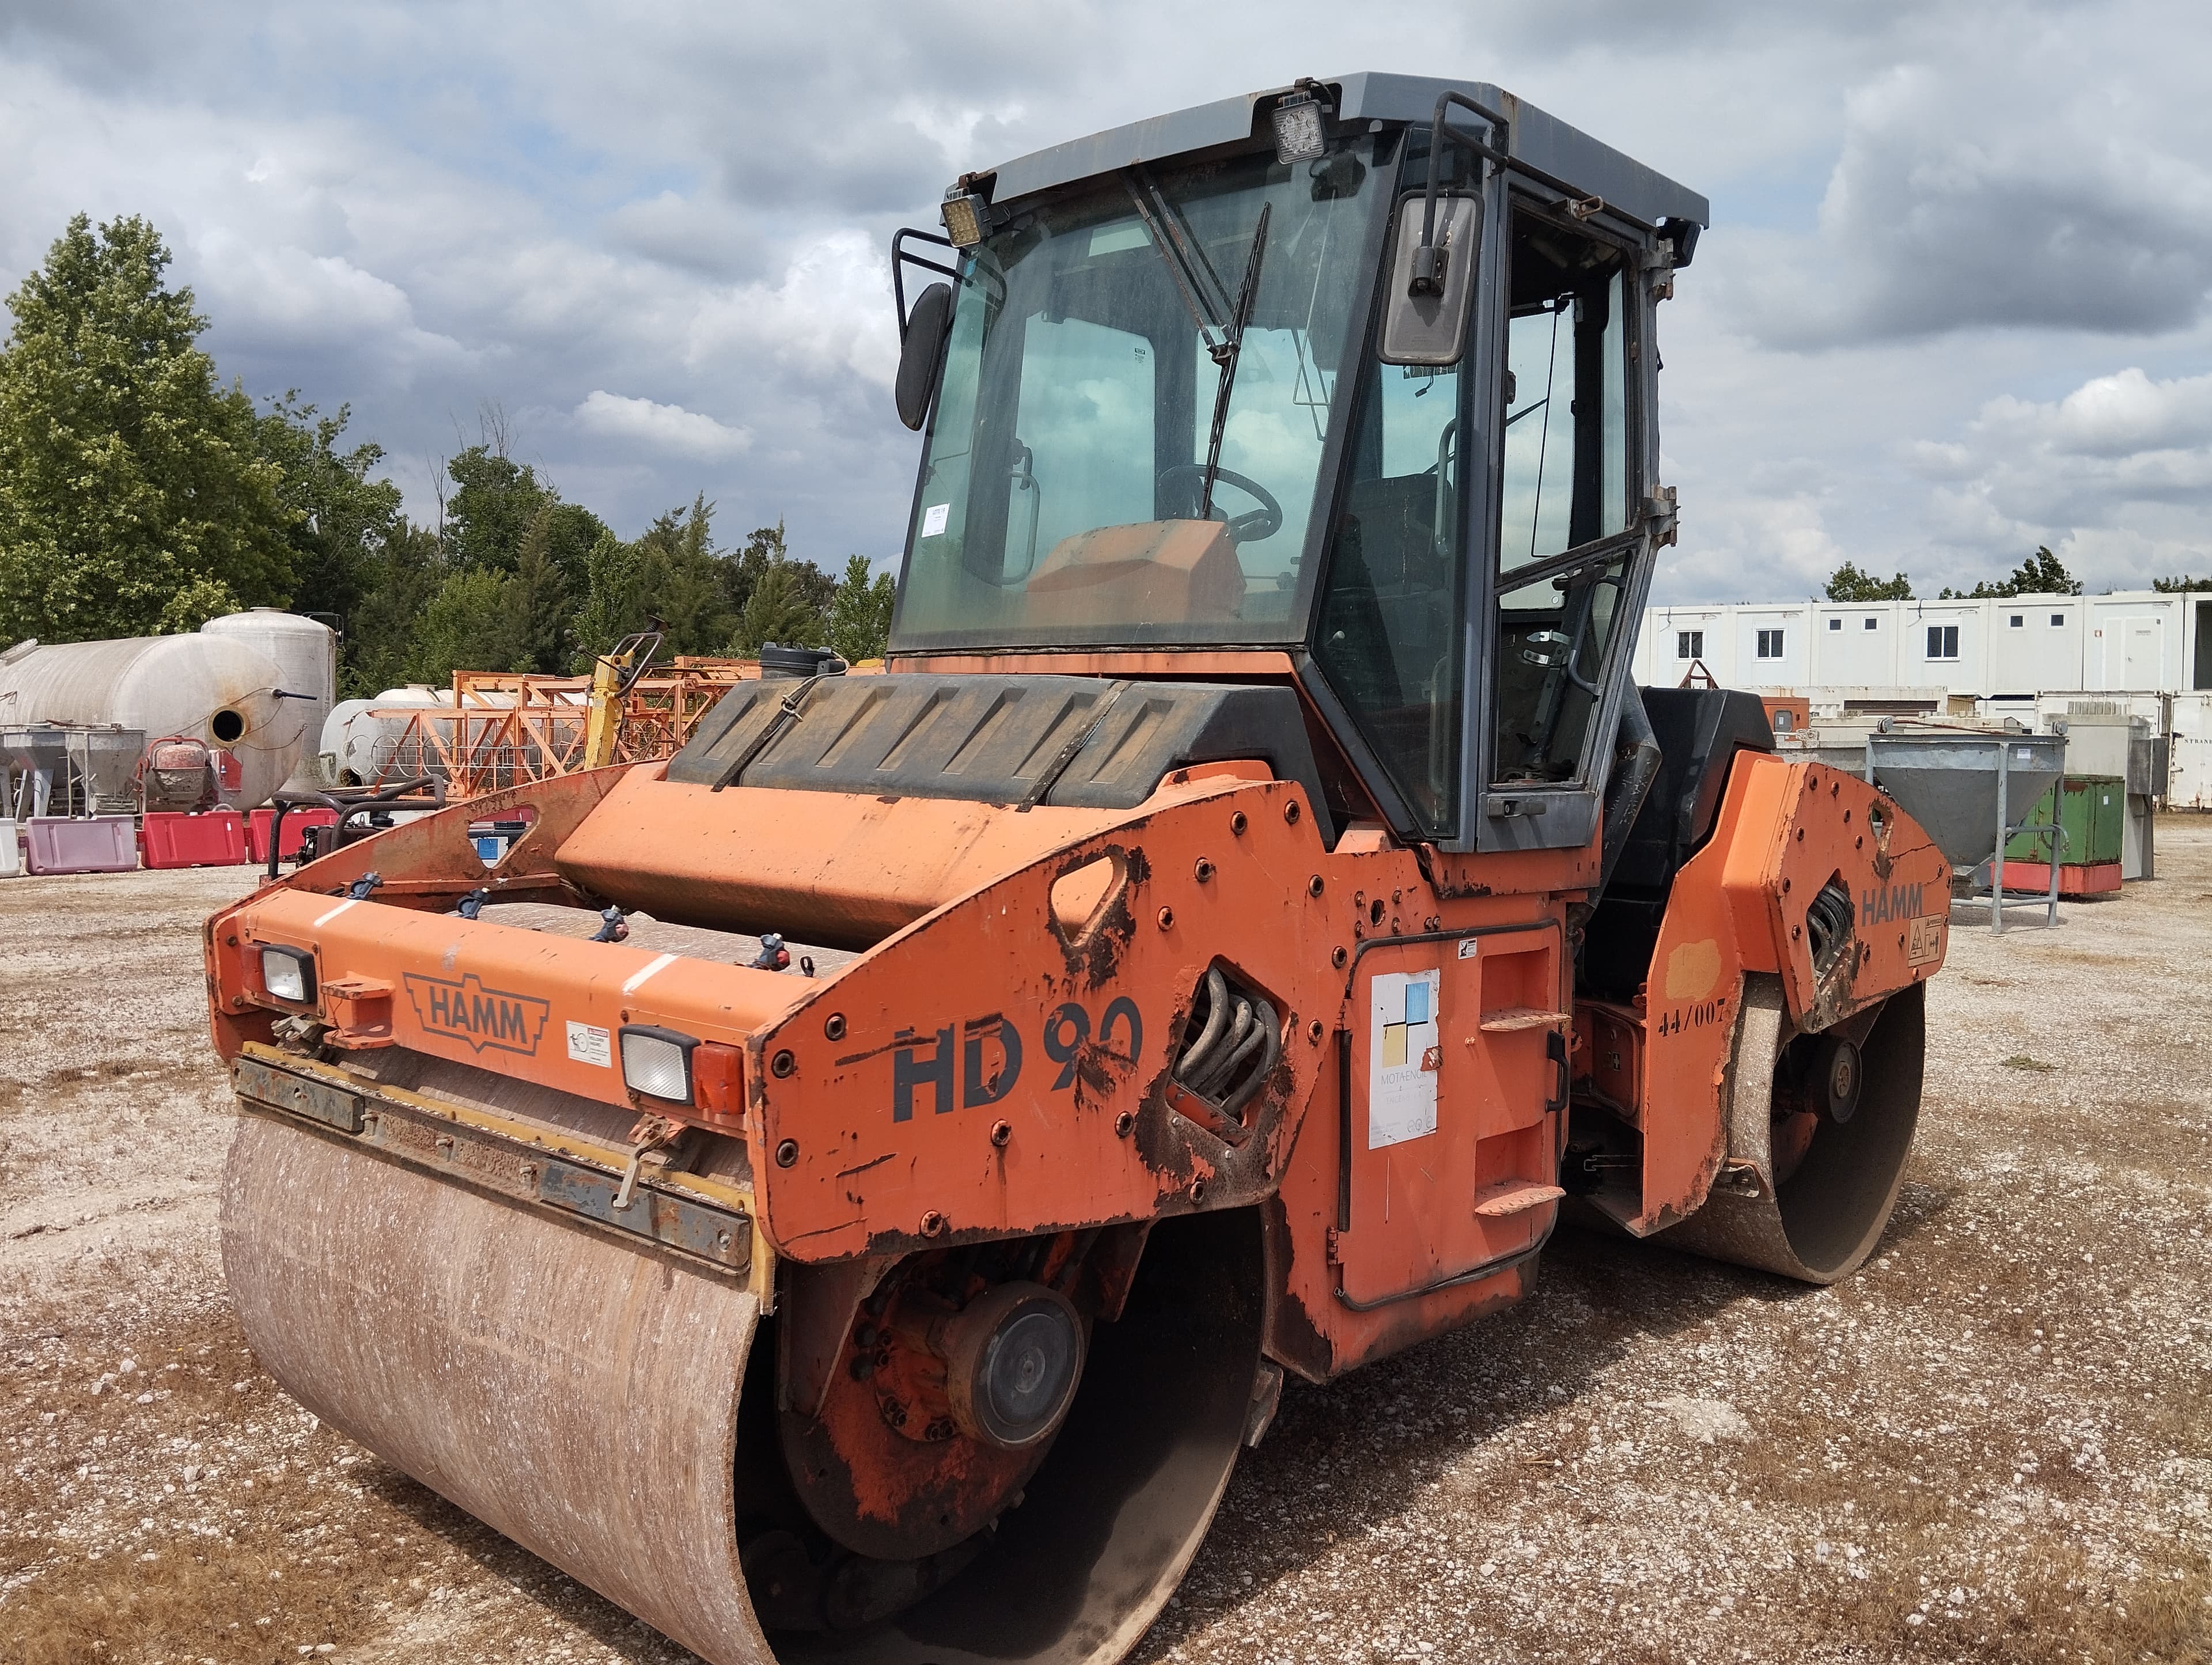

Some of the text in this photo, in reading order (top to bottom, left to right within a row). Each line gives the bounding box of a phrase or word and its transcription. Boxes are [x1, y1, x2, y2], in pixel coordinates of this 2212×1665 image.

[1862, 882, 1923, 927] HAMM
[429, 985, 528, 1045] HAMM
[1658, 998, 1726, 1037] 44/007
[893, 996, 1143, 1123] HD 90
